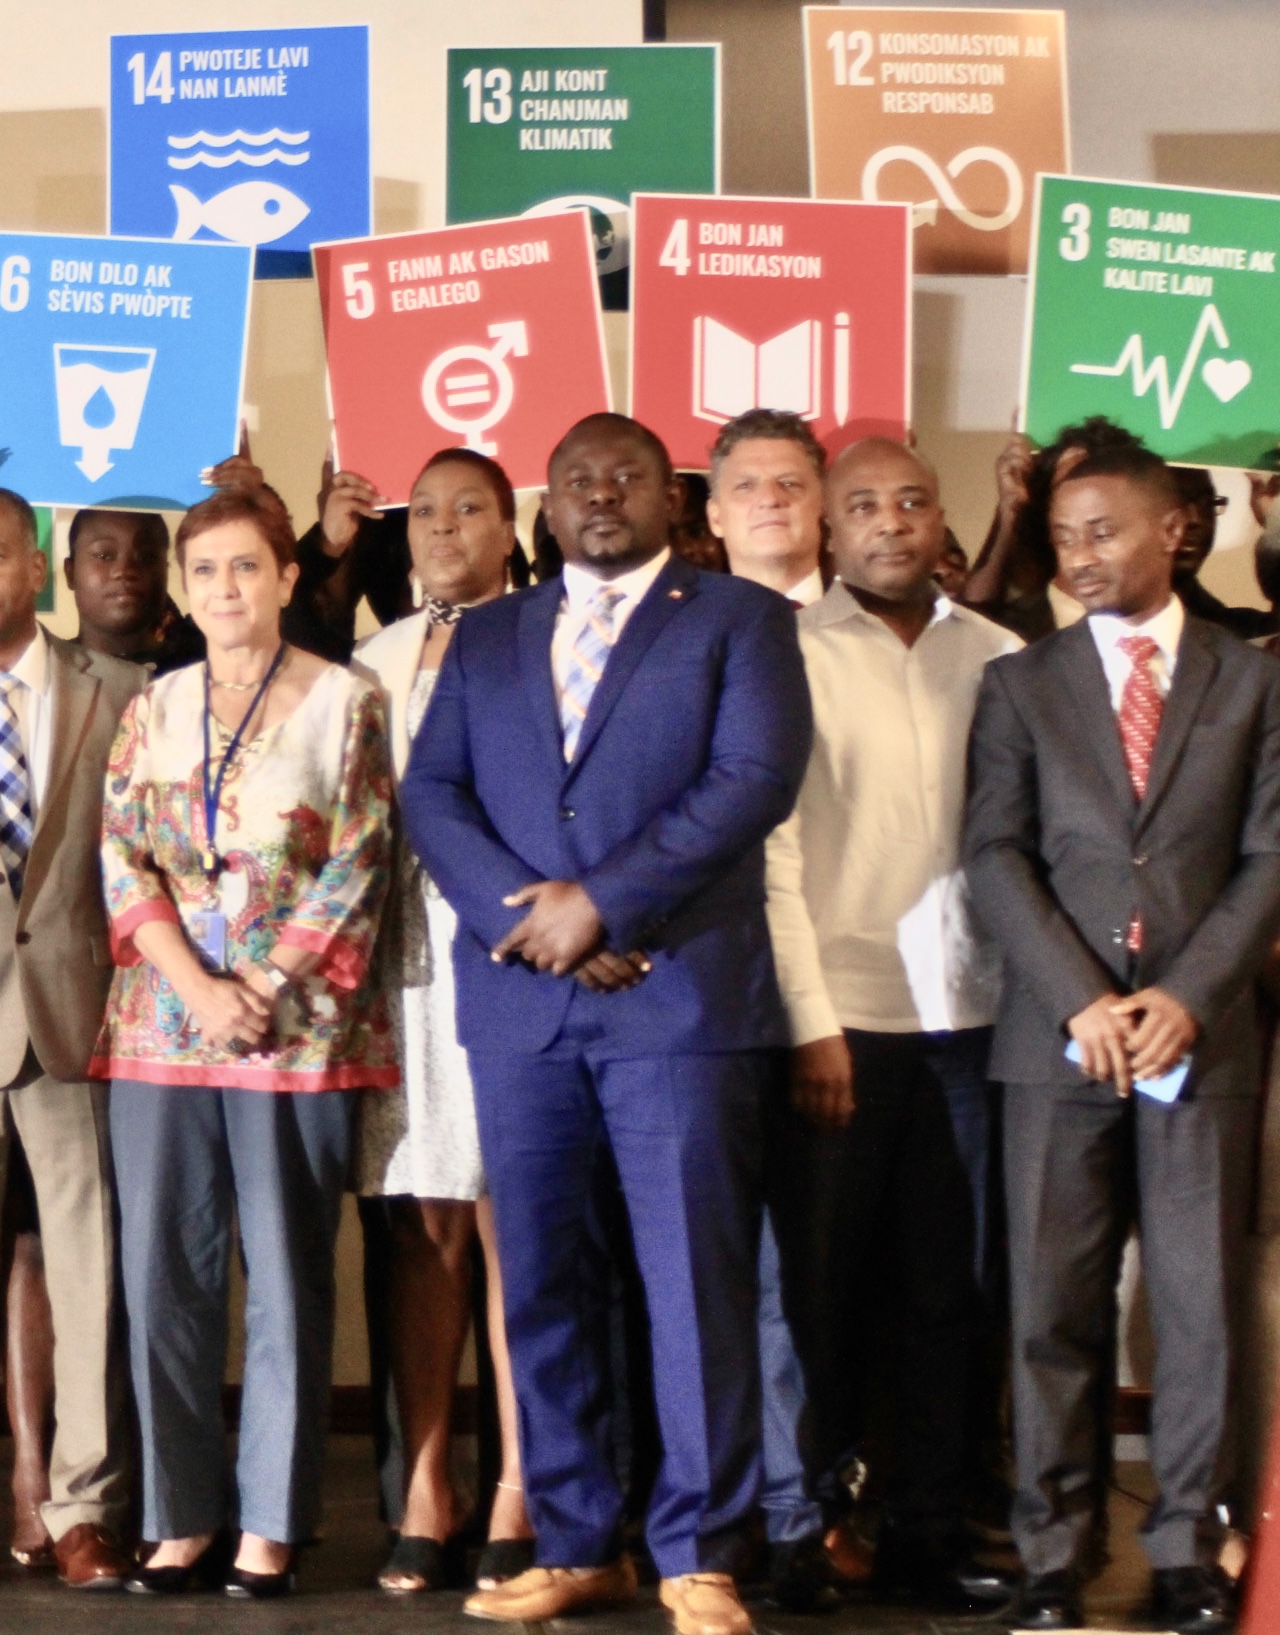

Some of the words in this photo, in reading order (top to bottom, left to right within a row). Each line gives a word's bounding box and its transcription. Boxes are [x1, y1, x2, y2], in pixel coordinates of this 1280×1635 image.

[179, 48, 262, 72] PWOTEJE
[267, 46, 309, 69] LAVI
[827, 30, 875, 86] 12
[879, 33, 1019, 57] KONSOMASYON
[1024, 36, 1050, 58] AK
[127, 51, 175, 105] 14
[179, 78, 219, 99] NAN
[224, 69, 288, 98] LANMÈ
[520, 70, 549, 93] AJI
[555, 69, 608, 92] KONT
[881, 62, 1005, 85] PWODIKSYON
[463, 67, 512, 124] 13
[521, 98, 629, 121] CHANJMAN
[882, 91, 994, 115] RESPONSAB
[520, 128, 613, 150] KLIMATIK
[699, 222, 742, 246] BON
[746, 224, 784, 247] JAN
[1059, 203, 1091, 262] 3
[1108, 206, 1150, 230] BON
[1151, 212, 1191, 234] JAN
[387, 255, 443, 283] FANM
[449, 250, 477, 275] AK
[480, 240, 550, 271] GASON
[659, 219, 691, 276] 4
[1105, 237, 1162, 262] SWEN
[1163, 243, 1248, 270] LASANTE
[1248, 251, 1276, 273] AK
[50, 259, 93, 283] BON
[98, 261, 139, 286] DLO
[143, 265, 173, 288] AK
[698, 253, 822, 279] LEDIKASYON
[341, 262, 375, 319] 5
[391, 280, 481, 312] EGALEGO
[1103, 267, 1169, 293] KALITE
[1170, 273, 1214, 297] LAVI
[47, 285, 105, 314] SÈVIS
[109, 289, 193, 319] PWÒPTE
